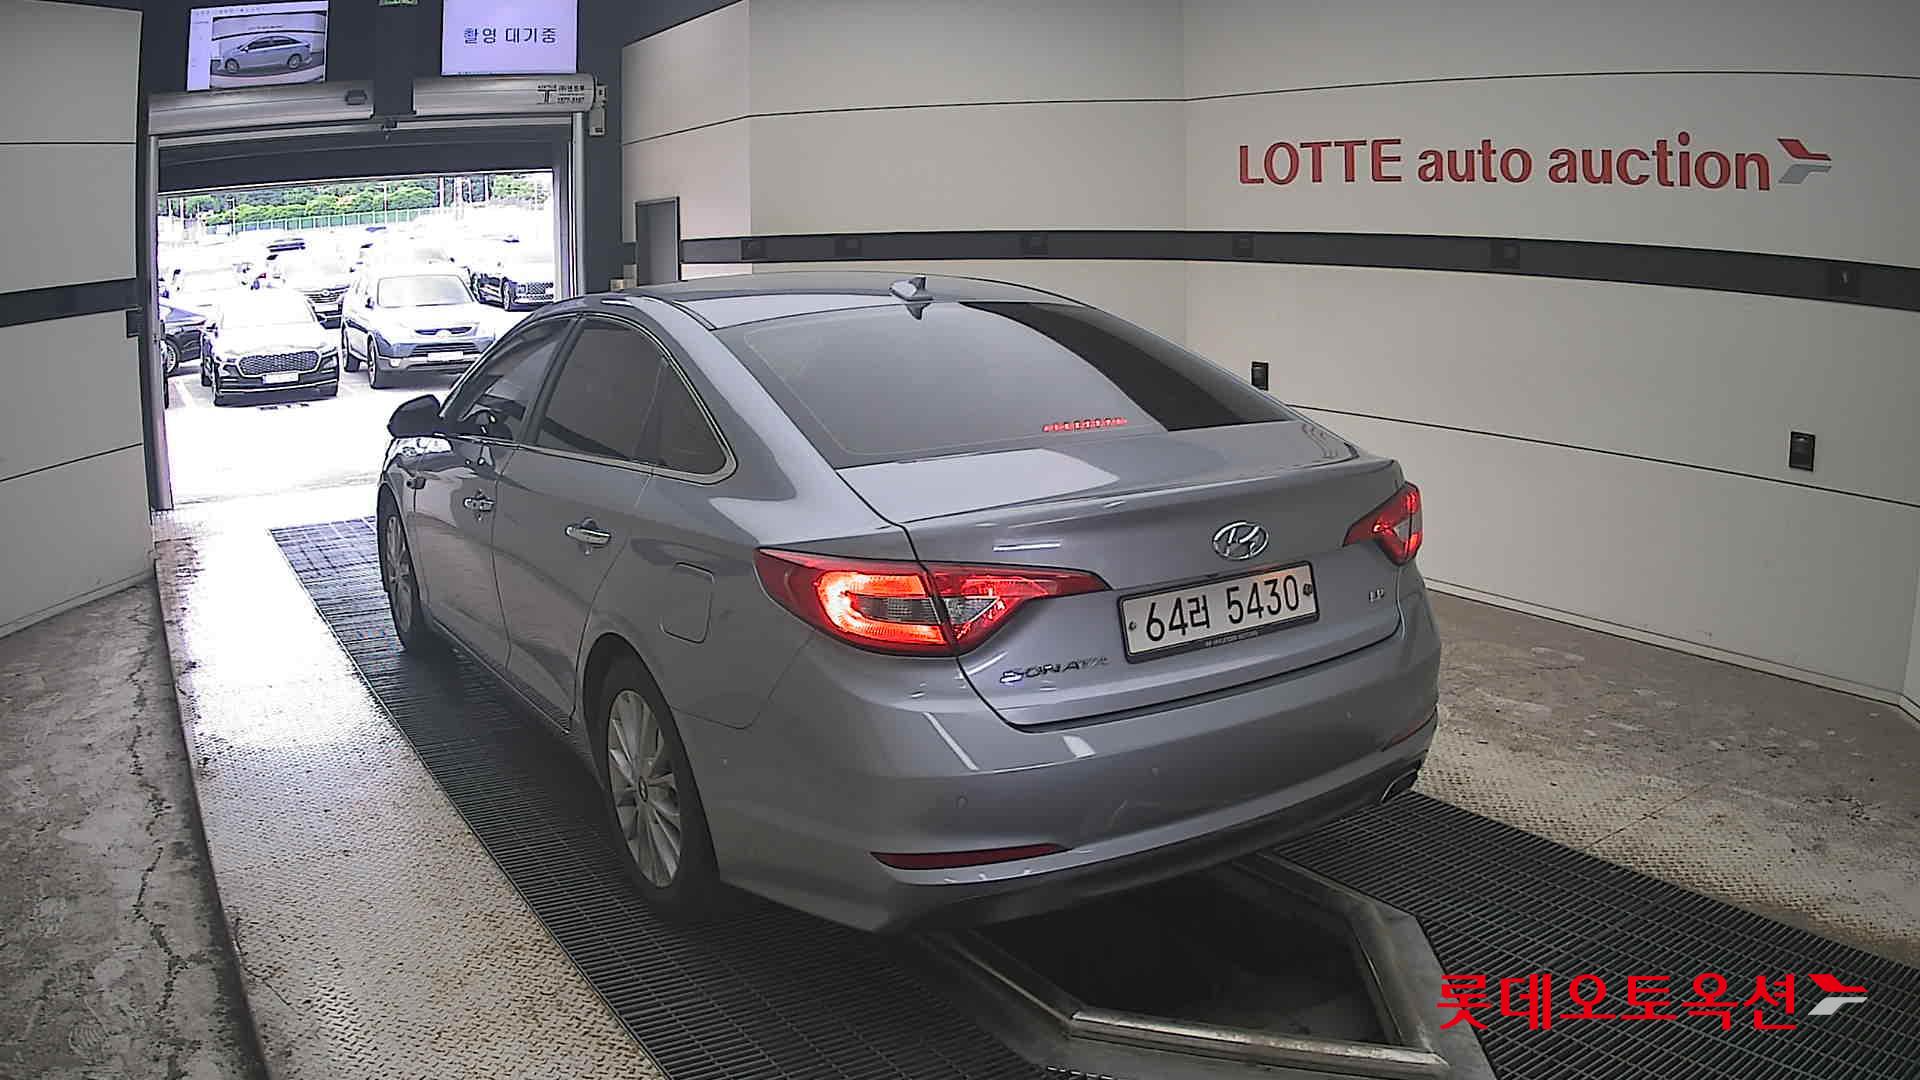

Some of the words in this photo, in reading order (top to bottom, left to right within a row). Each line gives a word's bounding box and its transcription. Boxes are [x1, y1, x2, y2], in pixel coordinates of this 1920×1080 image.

[463, 27, 497, 44] 촬영
[505, 27, 556, 44] 대기중
[1239, 138, 1401, 184] LOTTE
[1418, 139, 1532, 183] auto
[1550, 132, 1770, 191] auction
[1146, 595, 1210, 642] 64러
[1226, 574, 1299, 625] 5430
[1000, 656, 1108, 684] SONA
